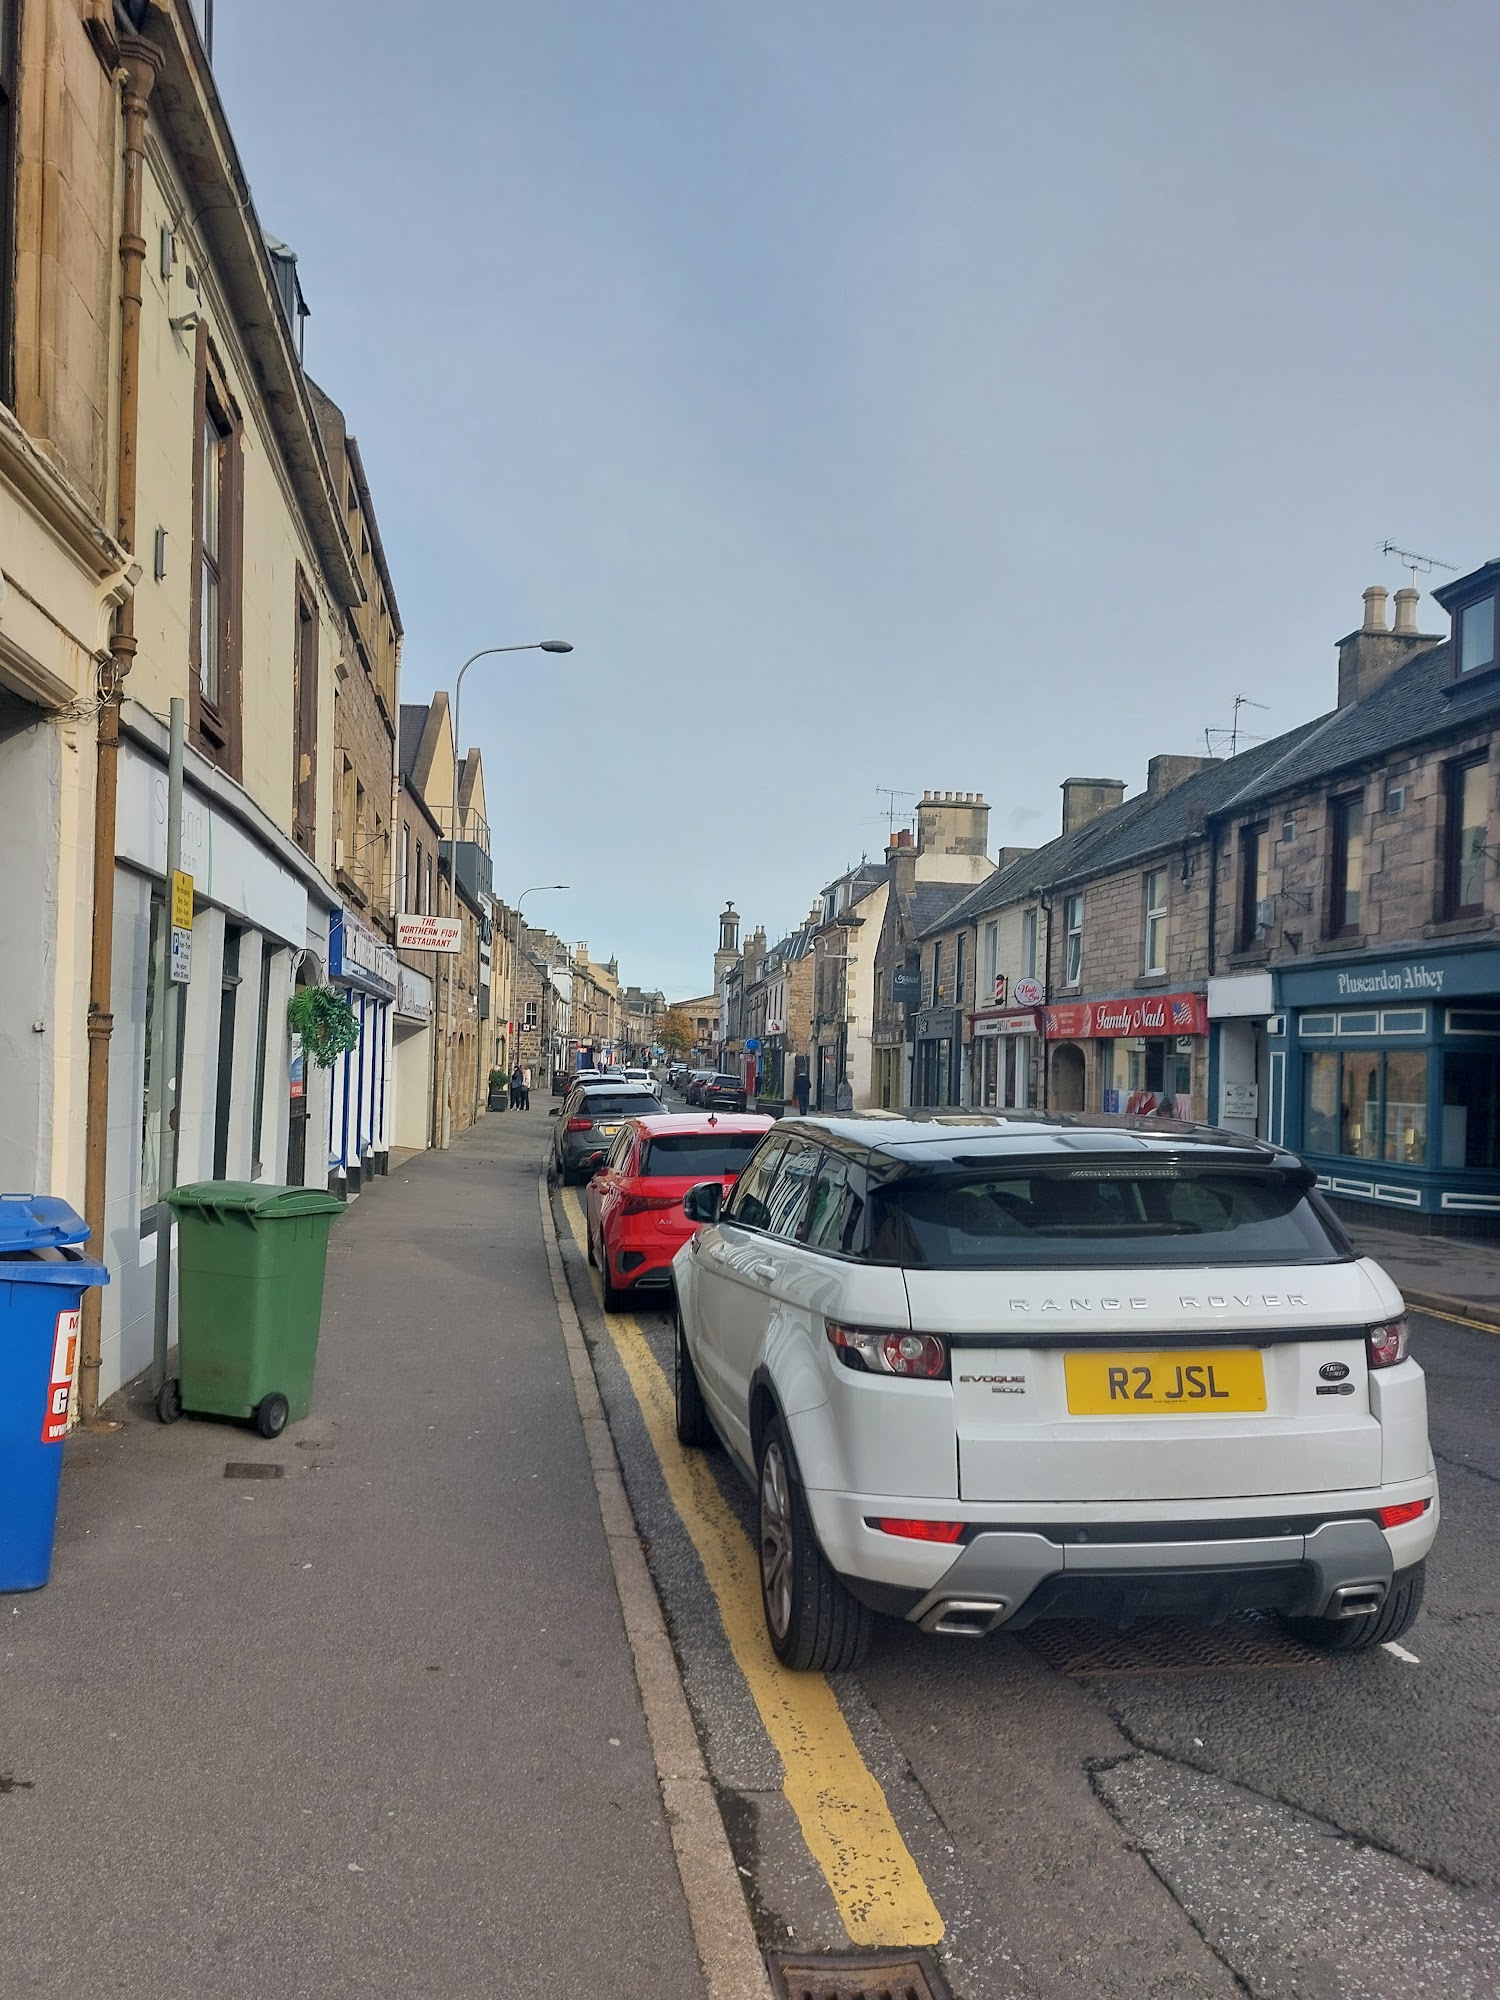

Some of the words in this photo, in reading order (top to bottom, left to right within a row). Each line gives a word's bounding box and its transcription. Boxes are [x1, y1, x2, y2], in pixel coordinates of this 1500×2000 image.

[421, 917, 437, 927] THE
[399, 925, 438, 937] NORTHERN
[440, 928, 459, 939] FISH
[402, 936, 452, 948] RESTAURANT
[1338, 969, 1402, 994] Pluscarden
[1403, 965, 1444, 992] Abbey
[1096, 1005, 1132, 1036] Family
[1133, 1001, 1166, 1029] Nails
[1009, 1297, 1149, 1311] RANGE
[1179, 1294, 1308, 1308] ROVER
[959, 1375, 1026, 1384] EVOQUE
[1108, 1366, 1153, 1400] R2
[1165, 1365, 1230, 1398] JSL
[992, 1385, 1026, 1394] SD4
